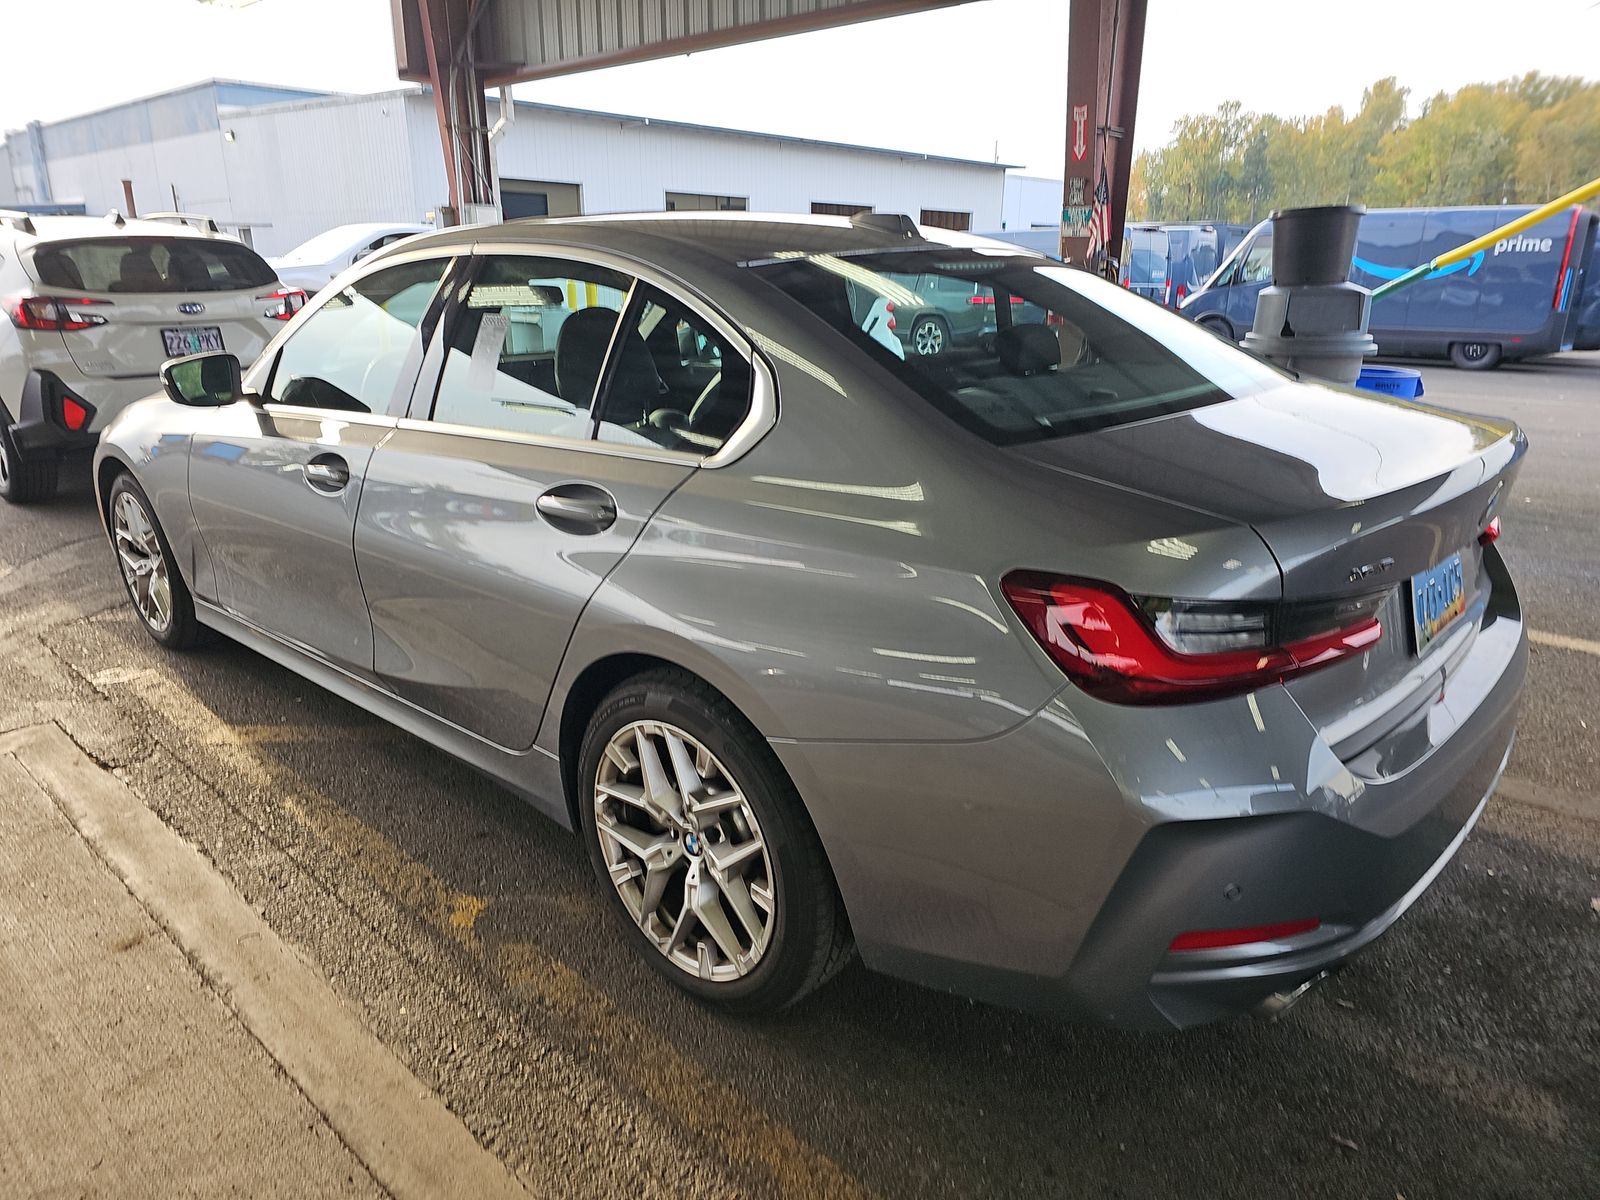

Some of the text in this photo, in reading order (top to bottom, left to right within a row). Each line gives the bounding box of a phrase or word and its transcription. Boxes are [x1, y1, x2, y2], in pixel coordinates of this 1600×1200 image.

[1494, 234, 1553, 257] prime
[167, 333, 220, 352] 226 PKY
